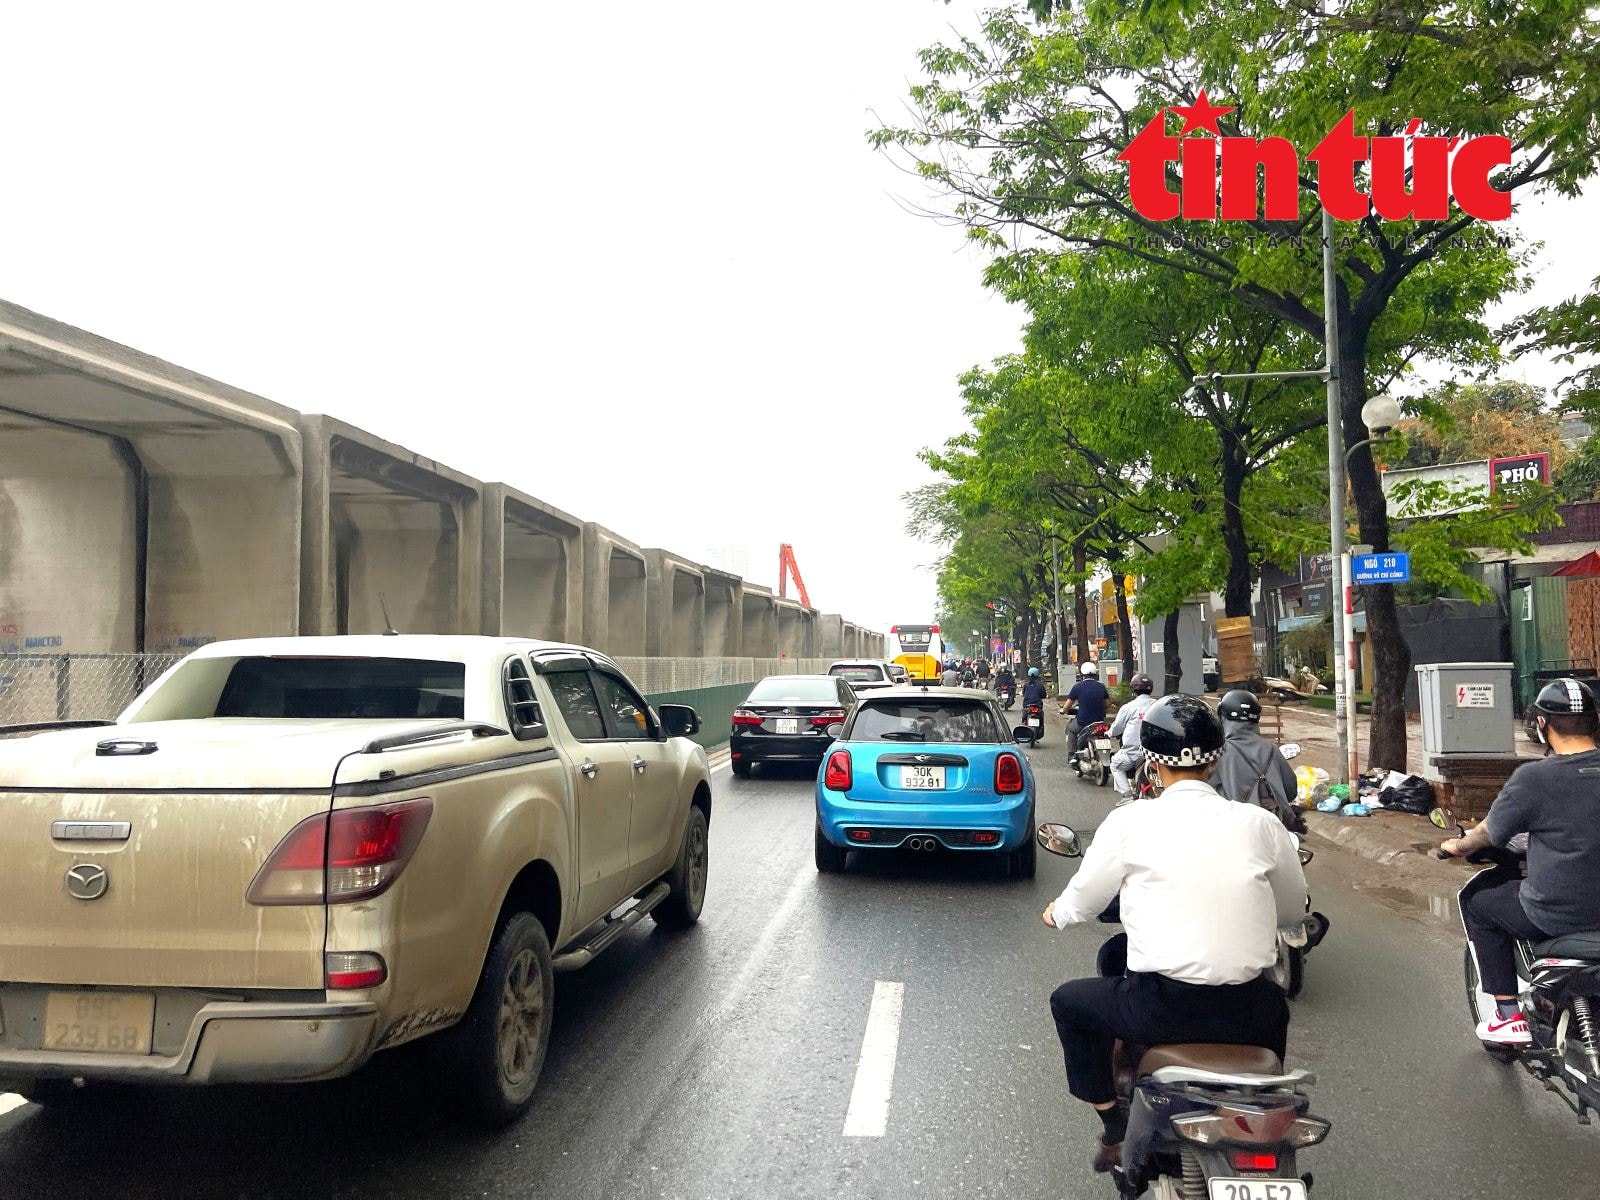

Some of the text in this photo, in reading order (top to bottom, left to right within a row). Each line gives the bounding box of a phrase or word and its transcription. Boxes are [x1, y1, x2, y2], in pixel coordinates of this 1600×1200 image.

[1500, 461, 1539, 484] PHỞ
[1384, 557, 1396, 568] 210
[914, 767, 932, 777] 30K
[905, 778, 940, 788] 932.81
